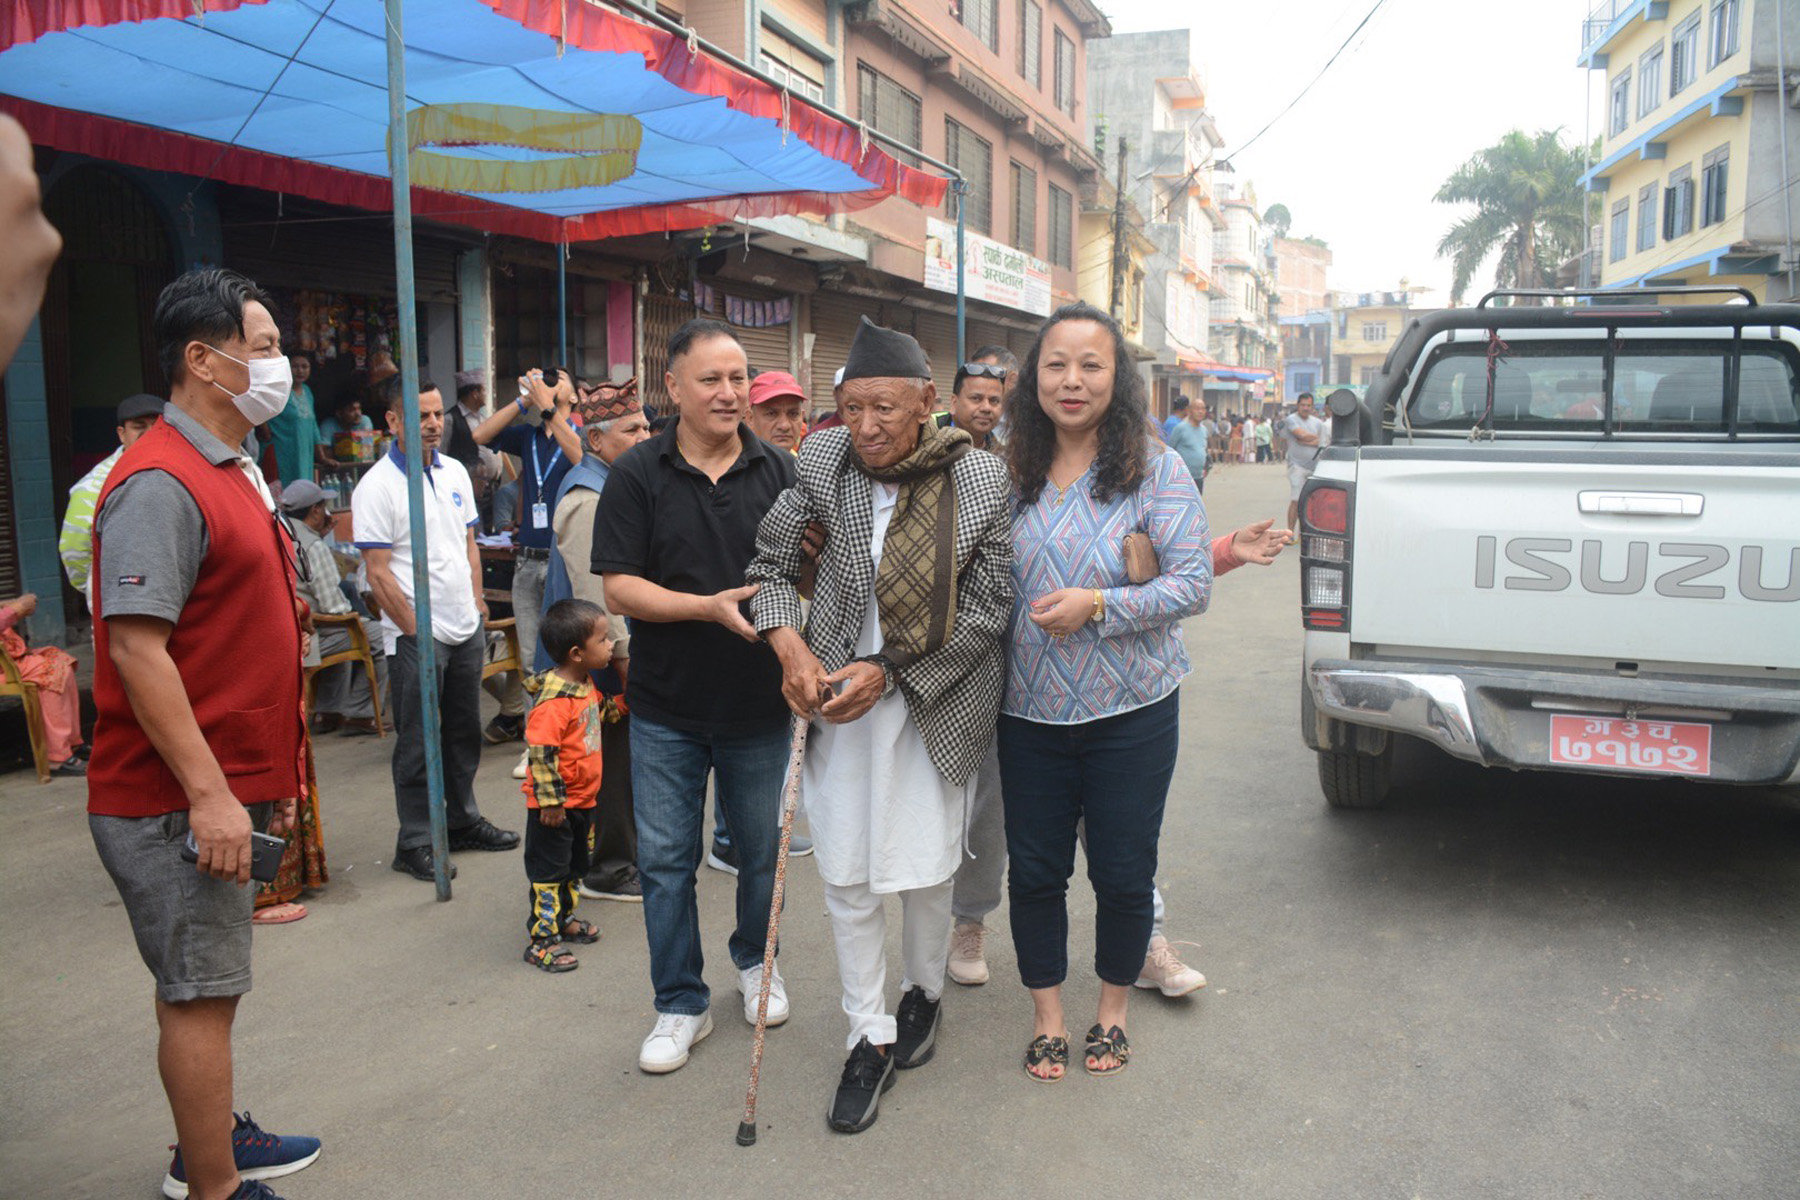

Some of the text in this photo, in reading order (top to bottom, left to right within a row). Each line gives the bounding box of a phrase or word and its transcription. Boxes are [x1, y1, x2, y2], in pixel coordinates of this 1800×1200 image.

[983, 266, 1024, 290] अस्पताल
[1475, 536, 1800, 602] ISUZU
[1560, 736, 1699, 770] ७१७२
